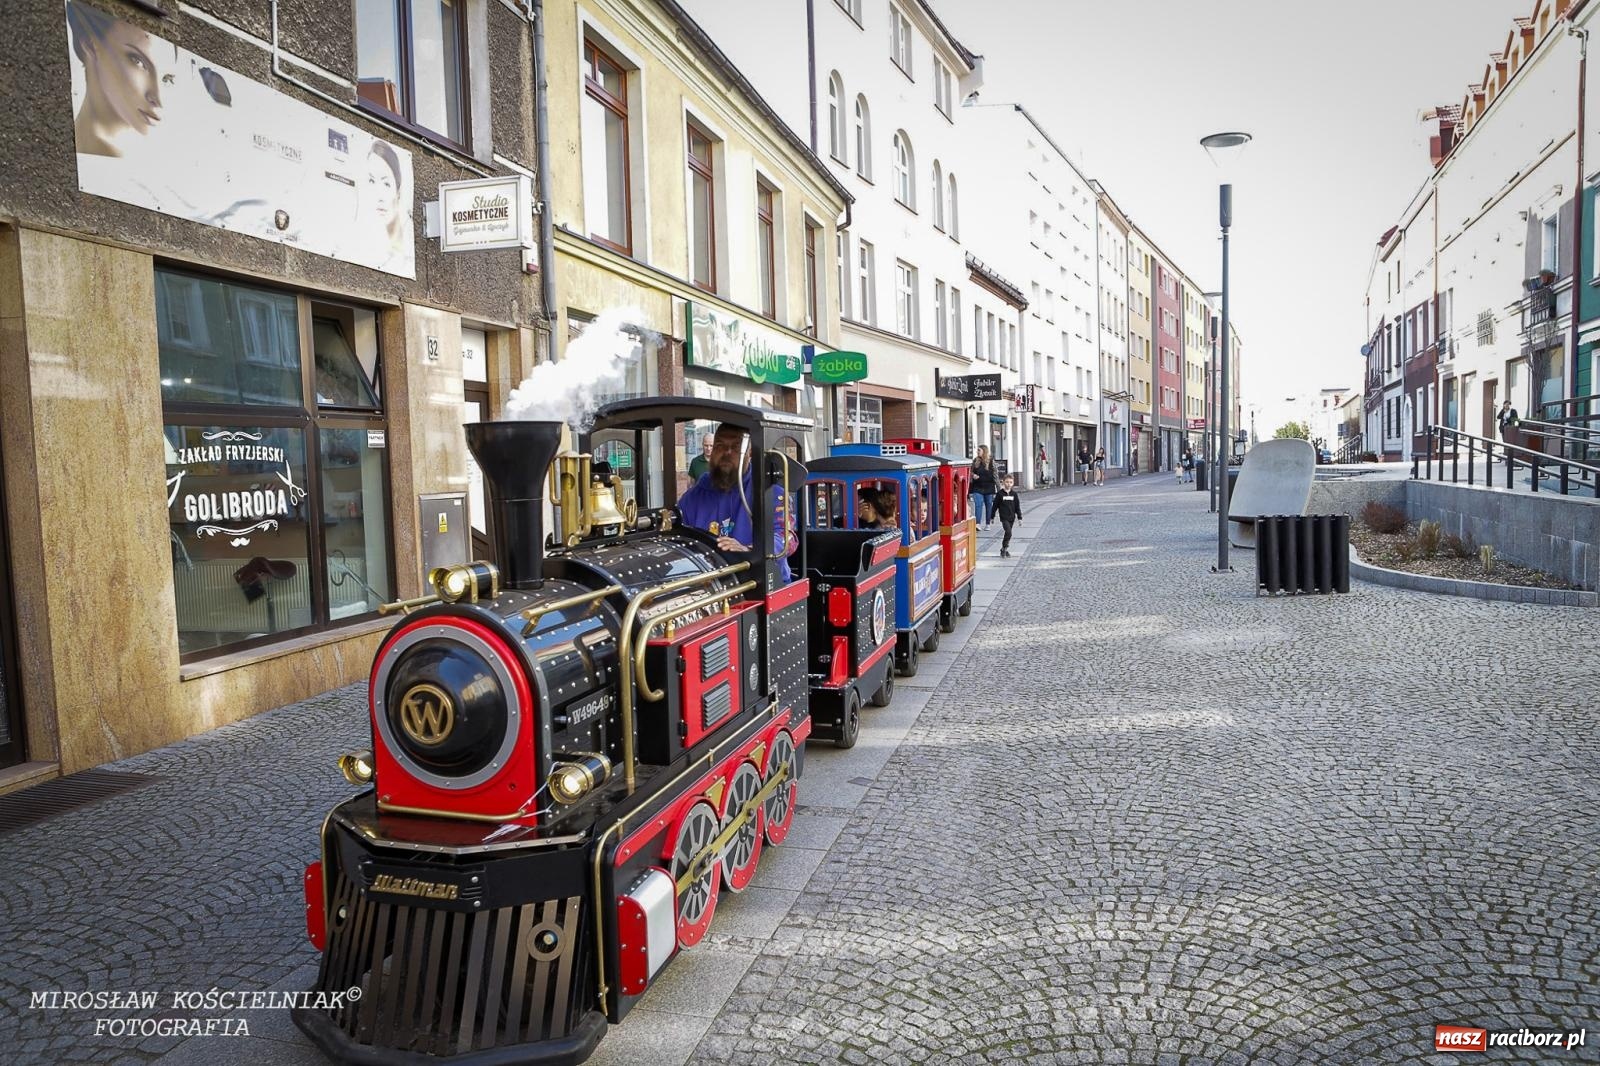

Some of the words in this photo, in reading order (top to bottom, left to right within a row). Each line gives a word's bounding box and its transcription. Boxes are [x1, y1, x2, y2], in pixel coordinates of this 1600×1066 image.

[472, 194, 508, 209] Studio
[453, 207, 509, 222] KOSMETYCZNE
[429, 340, 439, 356] 32
[818, 359, 863, 373] żabka
[178, 445, 222, 464] ZAKŁAD
[225, 444, 284, 462] FRYZJERSKI
[184, 489, 289, 522] GOLIBRODA
